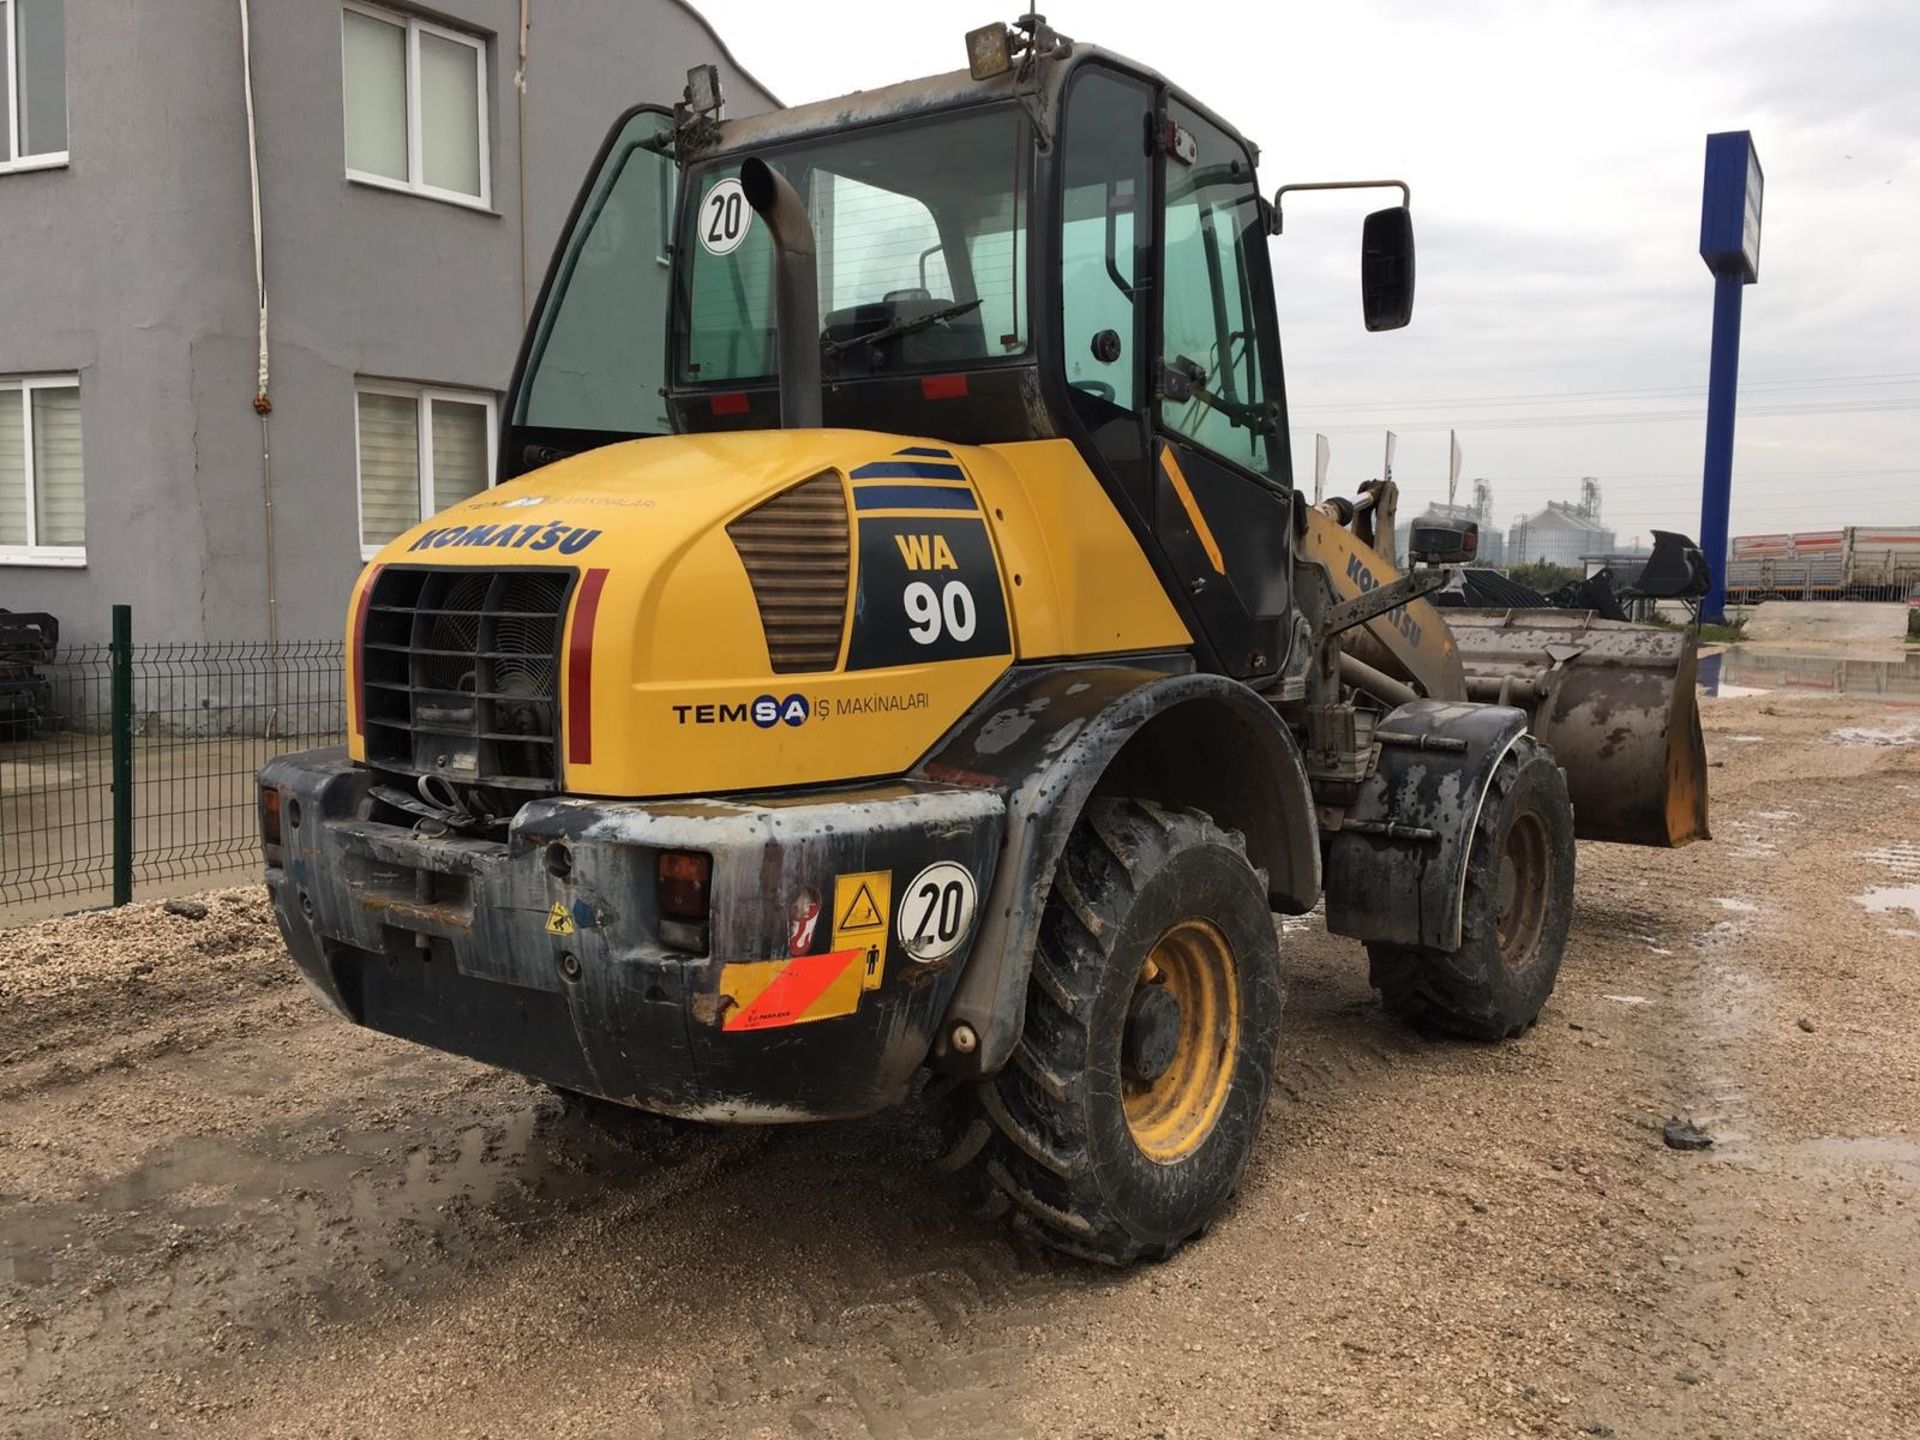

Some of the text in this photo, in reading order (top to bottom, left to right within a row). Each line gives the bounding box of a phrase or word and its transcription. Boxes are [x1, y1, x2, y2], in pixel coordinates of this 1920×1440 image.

[708, 192, 742, 242] 20
[407, 520, 602, 555] KOMATSU
[894, 535, 959, 570] WA
[903, 580, 976, 646] 90
[672, 692, 929, 726] TEMSA İŞ MAKİNALARI
[914, 880, 964, 945] 20
